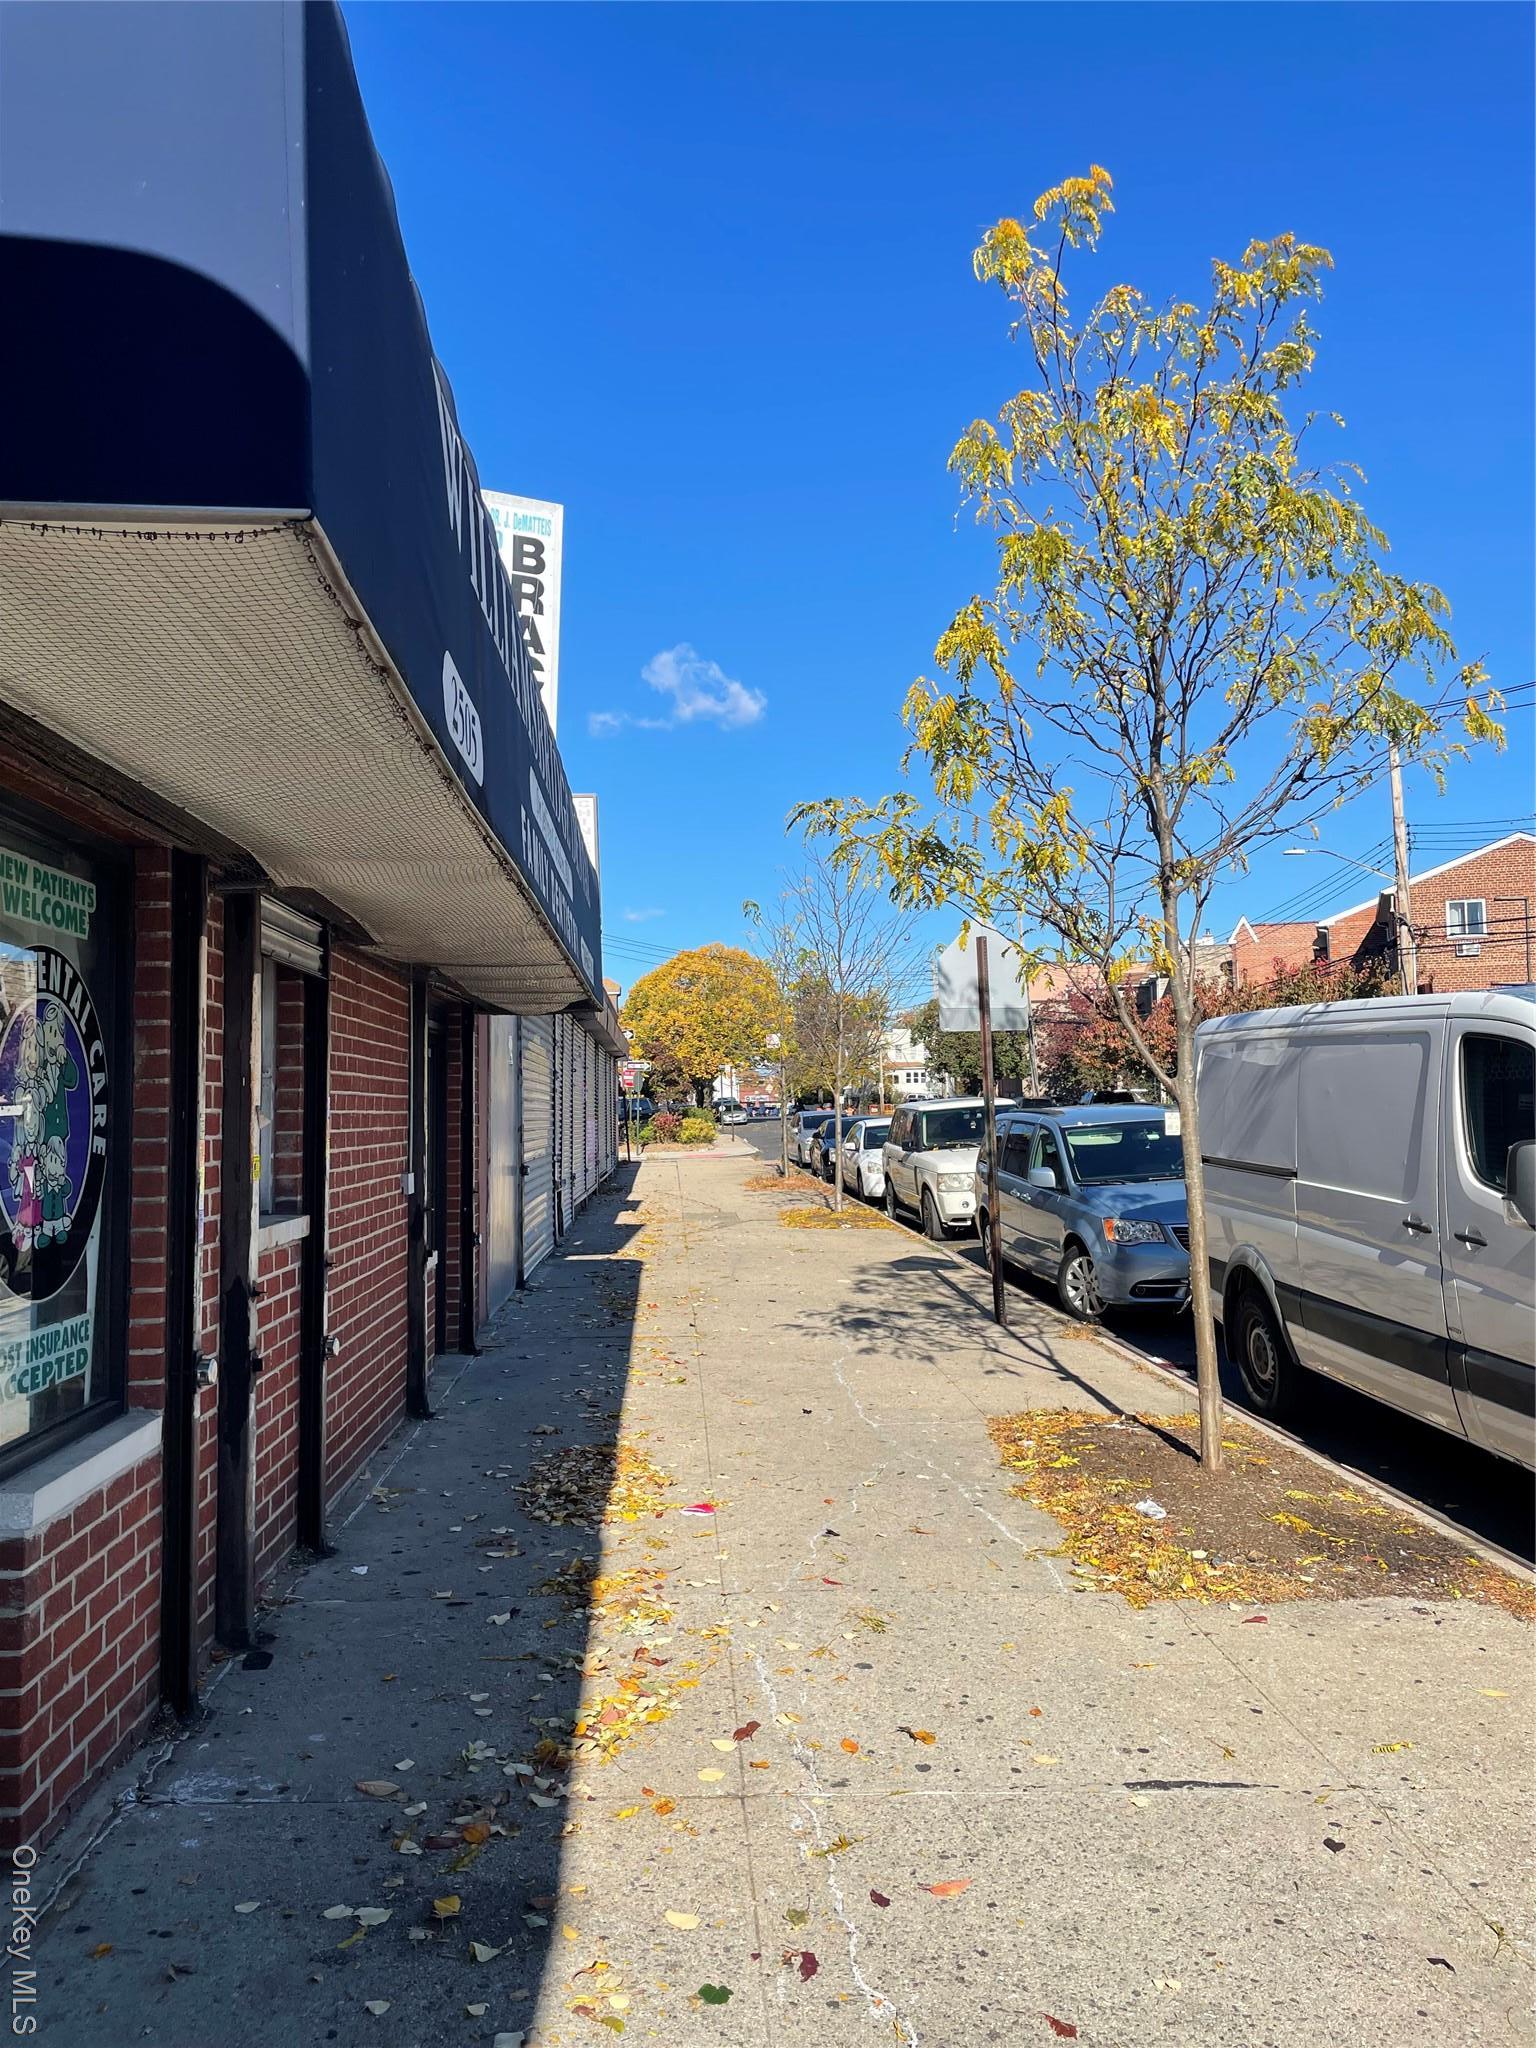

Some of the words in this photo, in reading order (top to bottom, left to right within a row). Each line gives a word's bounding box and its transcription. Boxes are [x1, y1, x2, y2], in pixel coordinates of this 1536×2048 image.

[503, 511, 511, 529] J.
[513, 511, 552, 537] DeMATTEIS
[451, 675, 477, 768] 2505
[520, 804, 549, 903] FAMILY
[3, 882, 87, 935] WELCOME
[33, 866, 95, 908] PATIENTS
[89, 1038, 109, 1156] CARE
[26, 1318, 90, 1364] INSURANCE
[0, 1347, 88, 1404] CCEPTED
